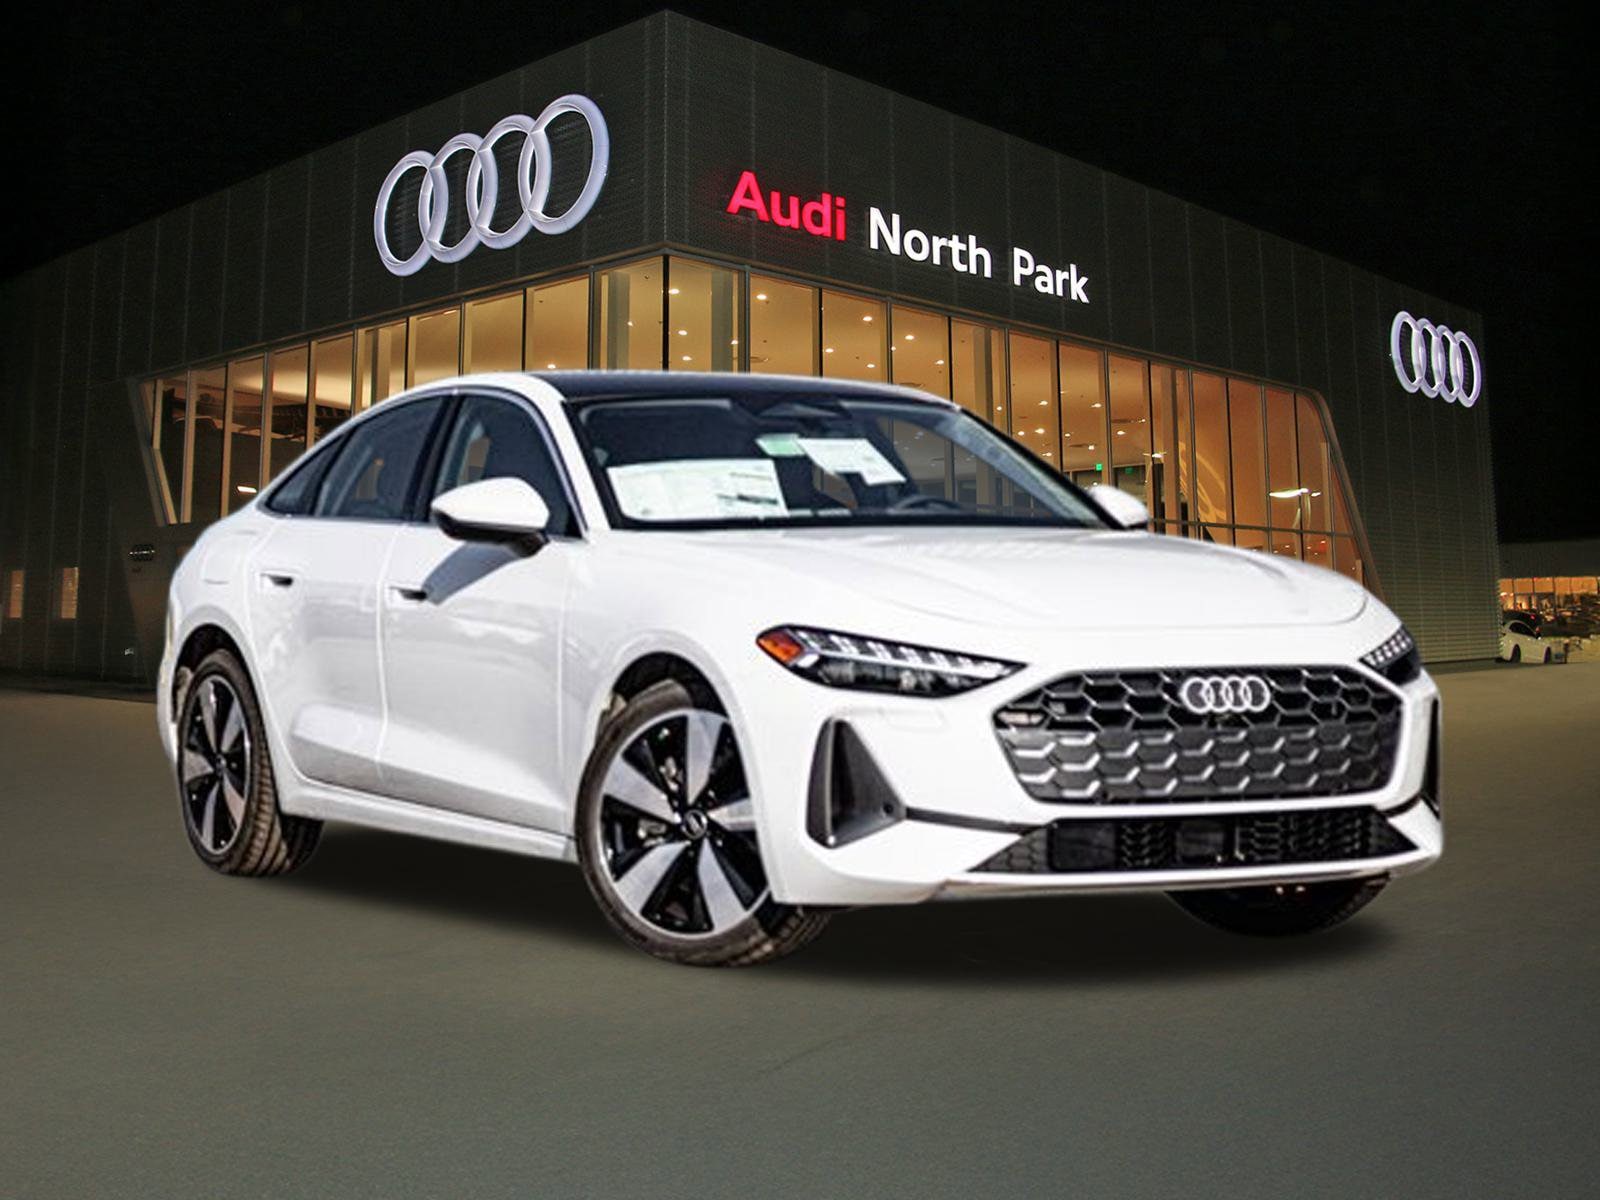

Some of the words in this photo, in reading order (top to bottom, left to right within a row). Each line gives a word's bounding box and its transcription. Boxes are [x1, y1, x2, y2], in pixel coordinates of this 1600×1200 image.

[727, 171, 846, 241] Audi
[869, 206, 992, 278] North
[1013, 246, 1090, 303] Park
